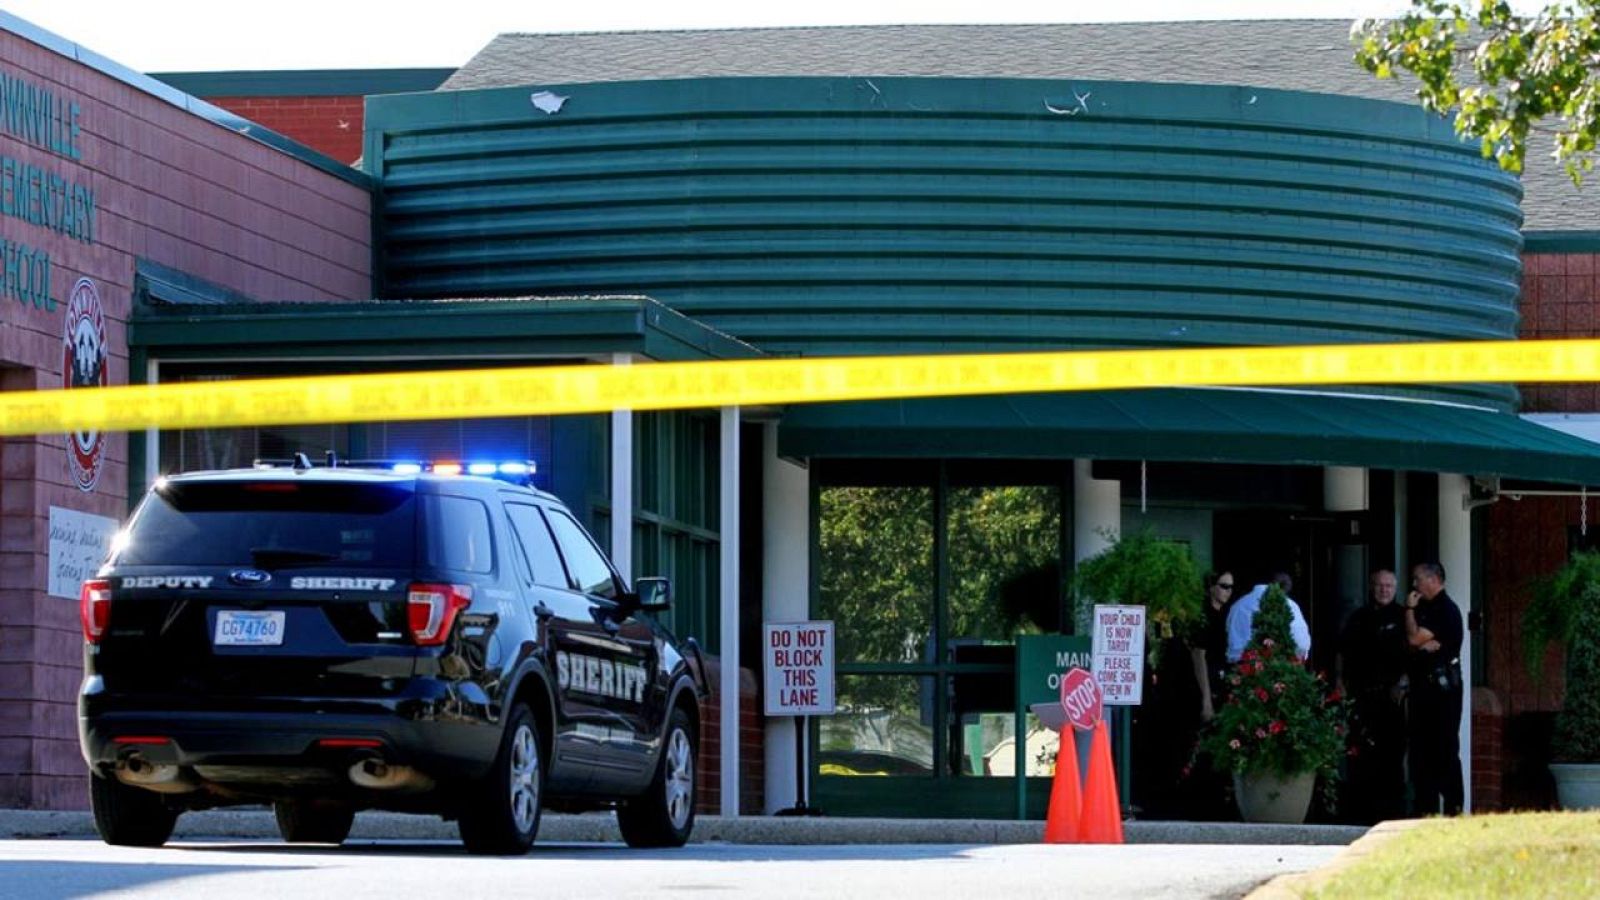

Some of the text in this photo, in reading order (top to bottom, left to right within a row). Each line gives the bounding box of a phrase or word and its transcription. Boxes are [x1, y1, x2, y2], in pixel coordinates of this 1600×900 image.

[121, 576, 213, 589] DEPUTY
[290, 576, 395, 592] SHERIFF
[221, 619, 277, 637] CG74760
[1099, 613, 1141, 626] YOUR CHILD
[771, 629, 826, 648] DO NOT
[1105, 627, 1132, 639] IS NOW
[1107, 639, 1130, 652] TARDY
[774, 649, 823, 667] BLOCK
[1056, 651, 1092, 668] MAIN
[1104, 657, 1131, 670] PLEASE
[556, 651, 647, 703] SHERIFF
[783, 669, 816, 687] THIS
[1048, 673, 1065, 690] O
[1098, 670, 1136, 683] COME SIGN
[780, 688, 819, 707] LANE
[1102, 684, 1132, 696] THEM IN
[1065, 677, 1097, 721] STOP
